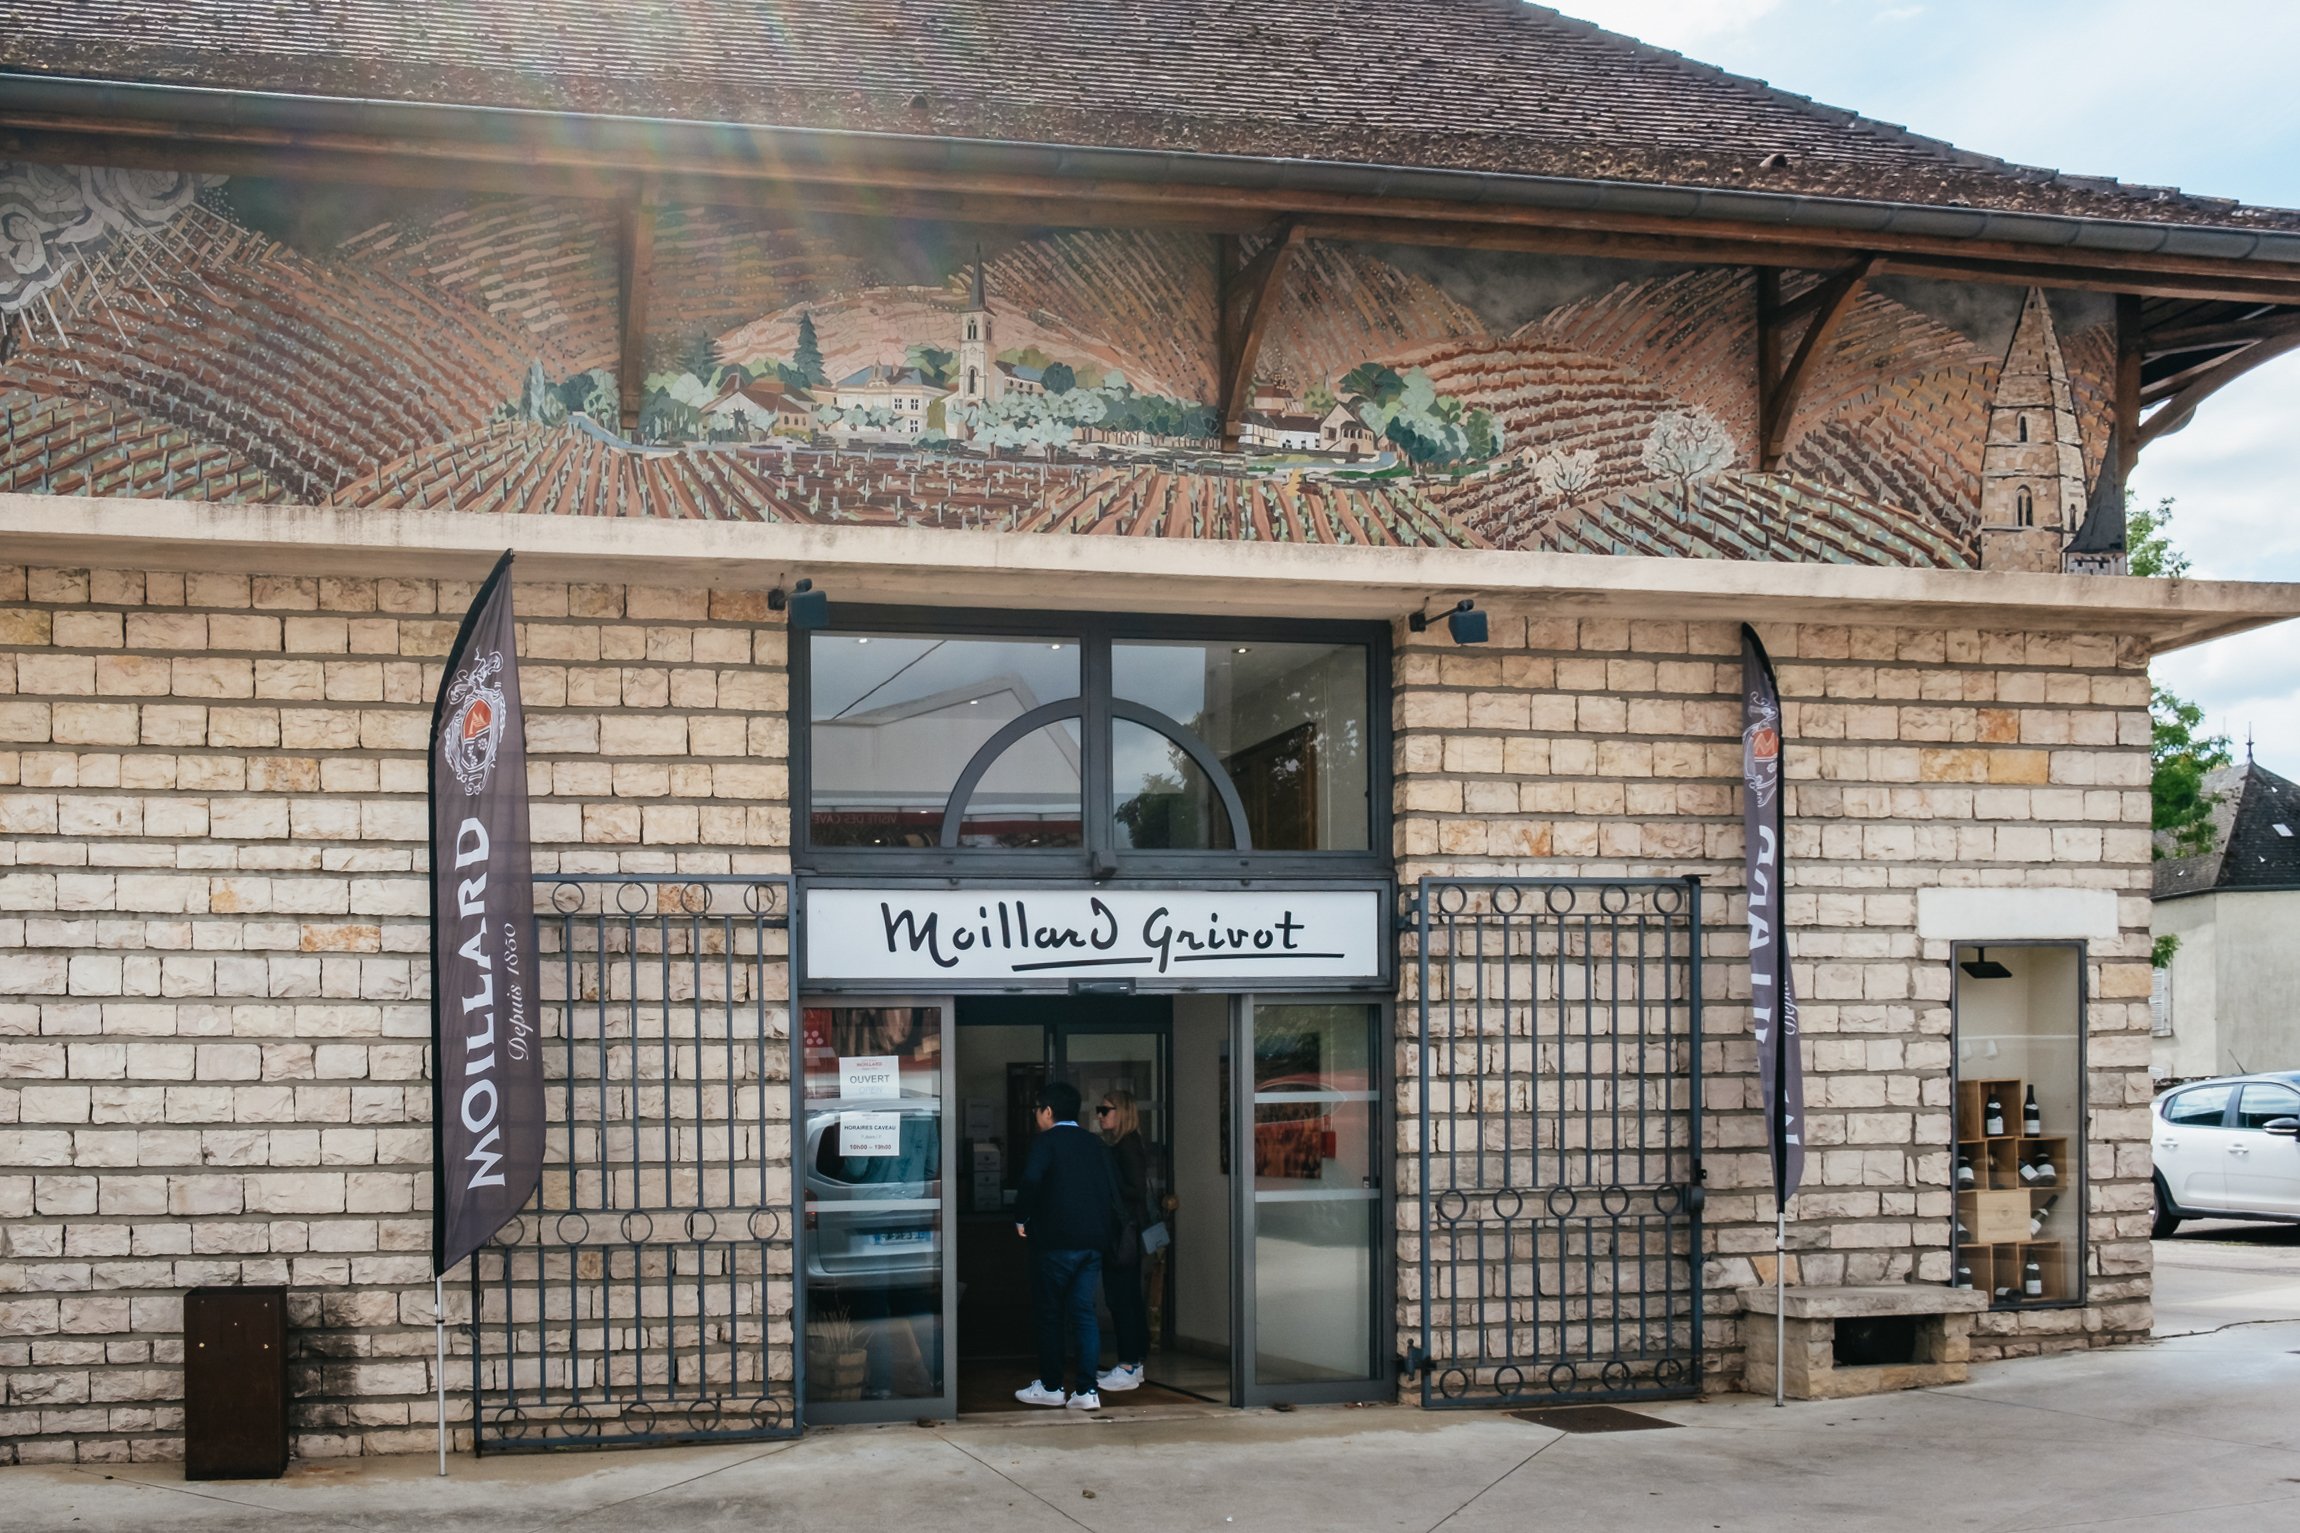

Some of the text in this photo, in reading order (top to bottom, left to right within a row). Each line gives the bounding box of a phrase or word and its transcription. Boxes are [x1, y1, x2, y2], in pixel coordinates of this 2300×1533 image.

[880, 896, 1305, 974] Moillard Grivot
[455, 817, 506, 1190] MOILLARD
[503, 922, 534, 1061] Depuis 1850
[849, 1074, 890, 1084] OUVERT
